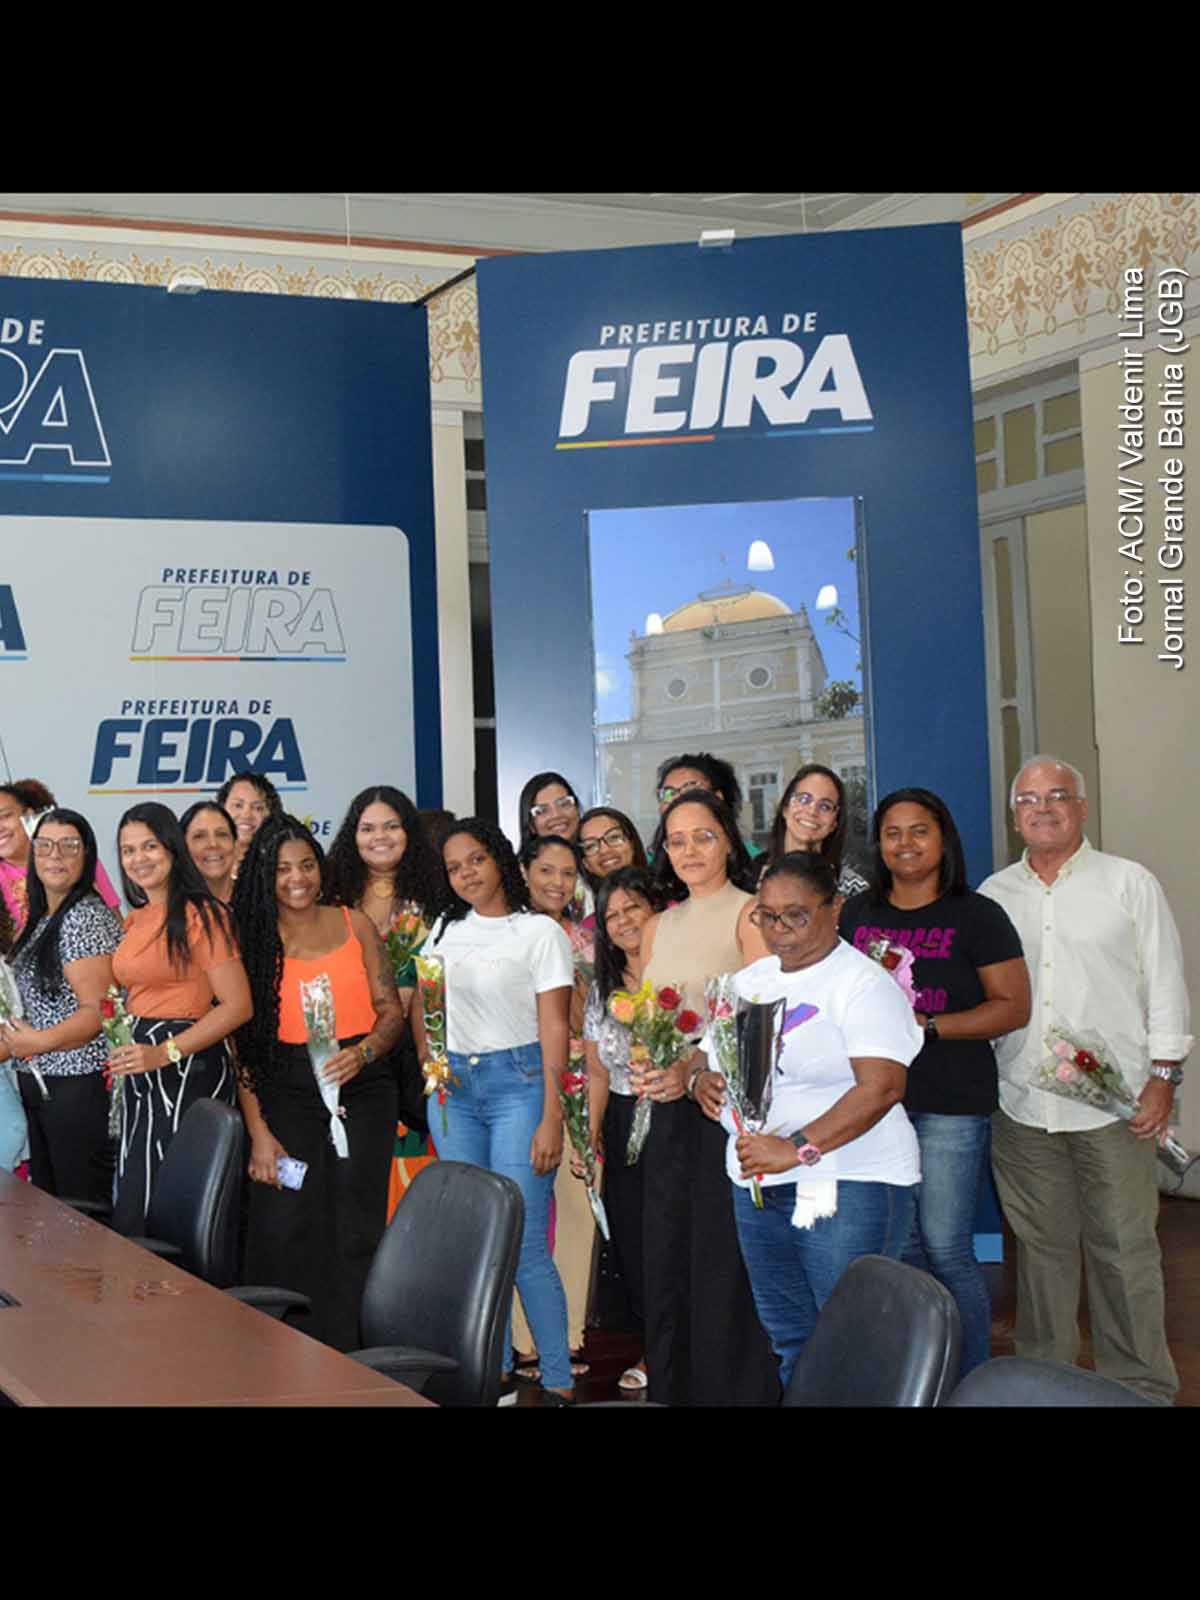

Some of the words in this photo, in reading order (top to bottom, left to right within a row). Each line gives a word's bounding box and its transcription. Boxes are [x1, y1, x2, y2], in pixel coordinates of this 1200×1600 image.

[0, 318, 46, 345] DE
[599, 314, 769, 346] PREFEITURA
[782, 311, 818, 335] DE
[558, 333, 874, 438] FEIRA
[162, 567, 278, 586] PREFEITURA
[285, 569, 311, 587] DE
[130, 585, 347, 654] FEIRA
[120, 699, 240, 716] PREFEITURA
[247, 699, 273, 715] DE
[89, 717, 307, 785] FEIRA
